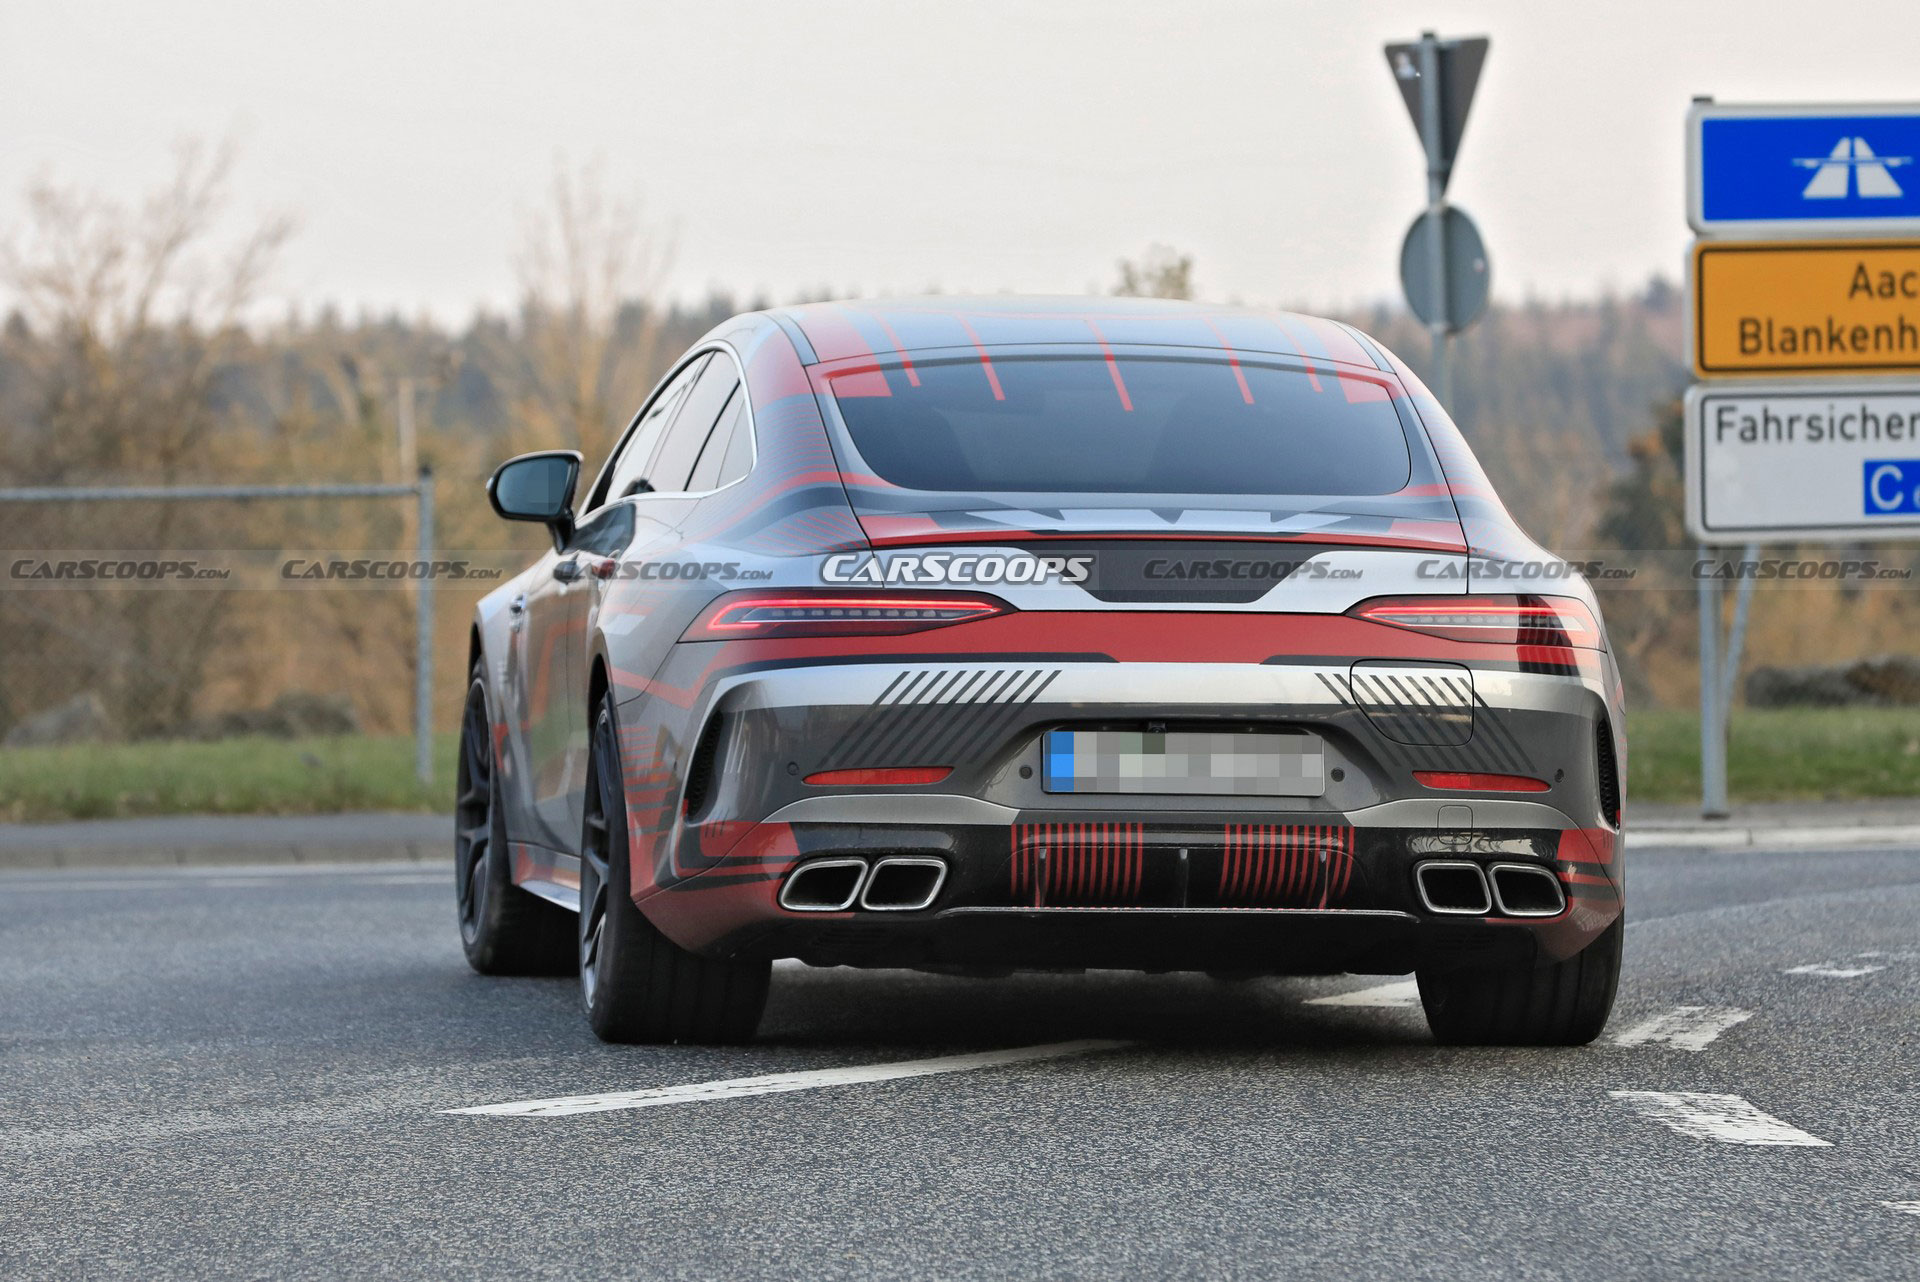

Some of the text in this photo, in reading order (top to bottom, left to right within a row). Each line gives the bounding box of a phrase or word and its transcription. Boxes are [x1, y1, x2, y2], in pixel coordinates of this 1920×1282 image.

[1848, 261, 1919, 300] Aac
[1739, 314, 1919, 355] Blankenh
[1716, 403, 1920, 442] Fahrsicher
